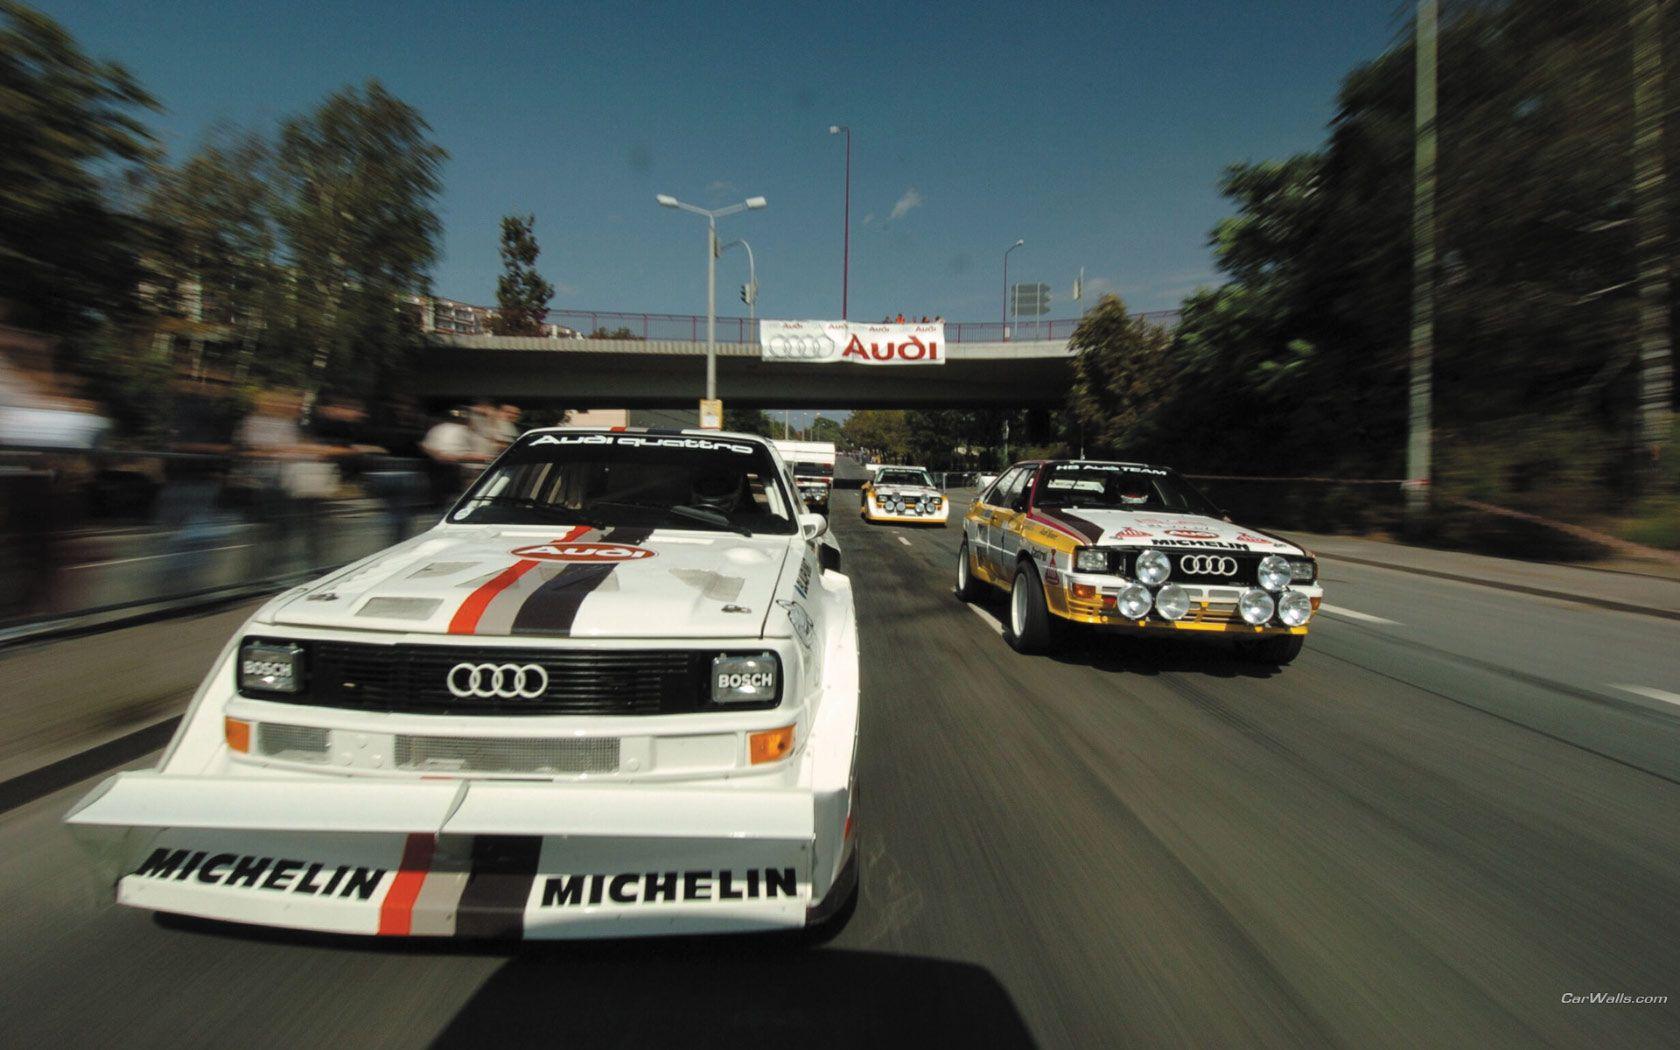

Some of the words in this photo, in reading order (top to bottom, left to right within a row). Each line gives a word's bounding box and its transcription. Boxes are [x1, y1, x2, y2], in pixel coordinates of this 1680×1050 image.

[842, 333, 938, 361] Audi
[528, 435, 614, 447] Audi
[617, 437, 754, 455] quattro
[1120, 466, 1167, 476] TEAM
[516, 545, 647, 558] Audi
[1151, 539, 1250, 551] MICHELIN
[243, 660, 292, 677] BOSCH
[718, 672, 773, 688] BOSCH
[135, 847, 389, 901] MICHELIN
[541, 867, 798, 907] MICHELIN
